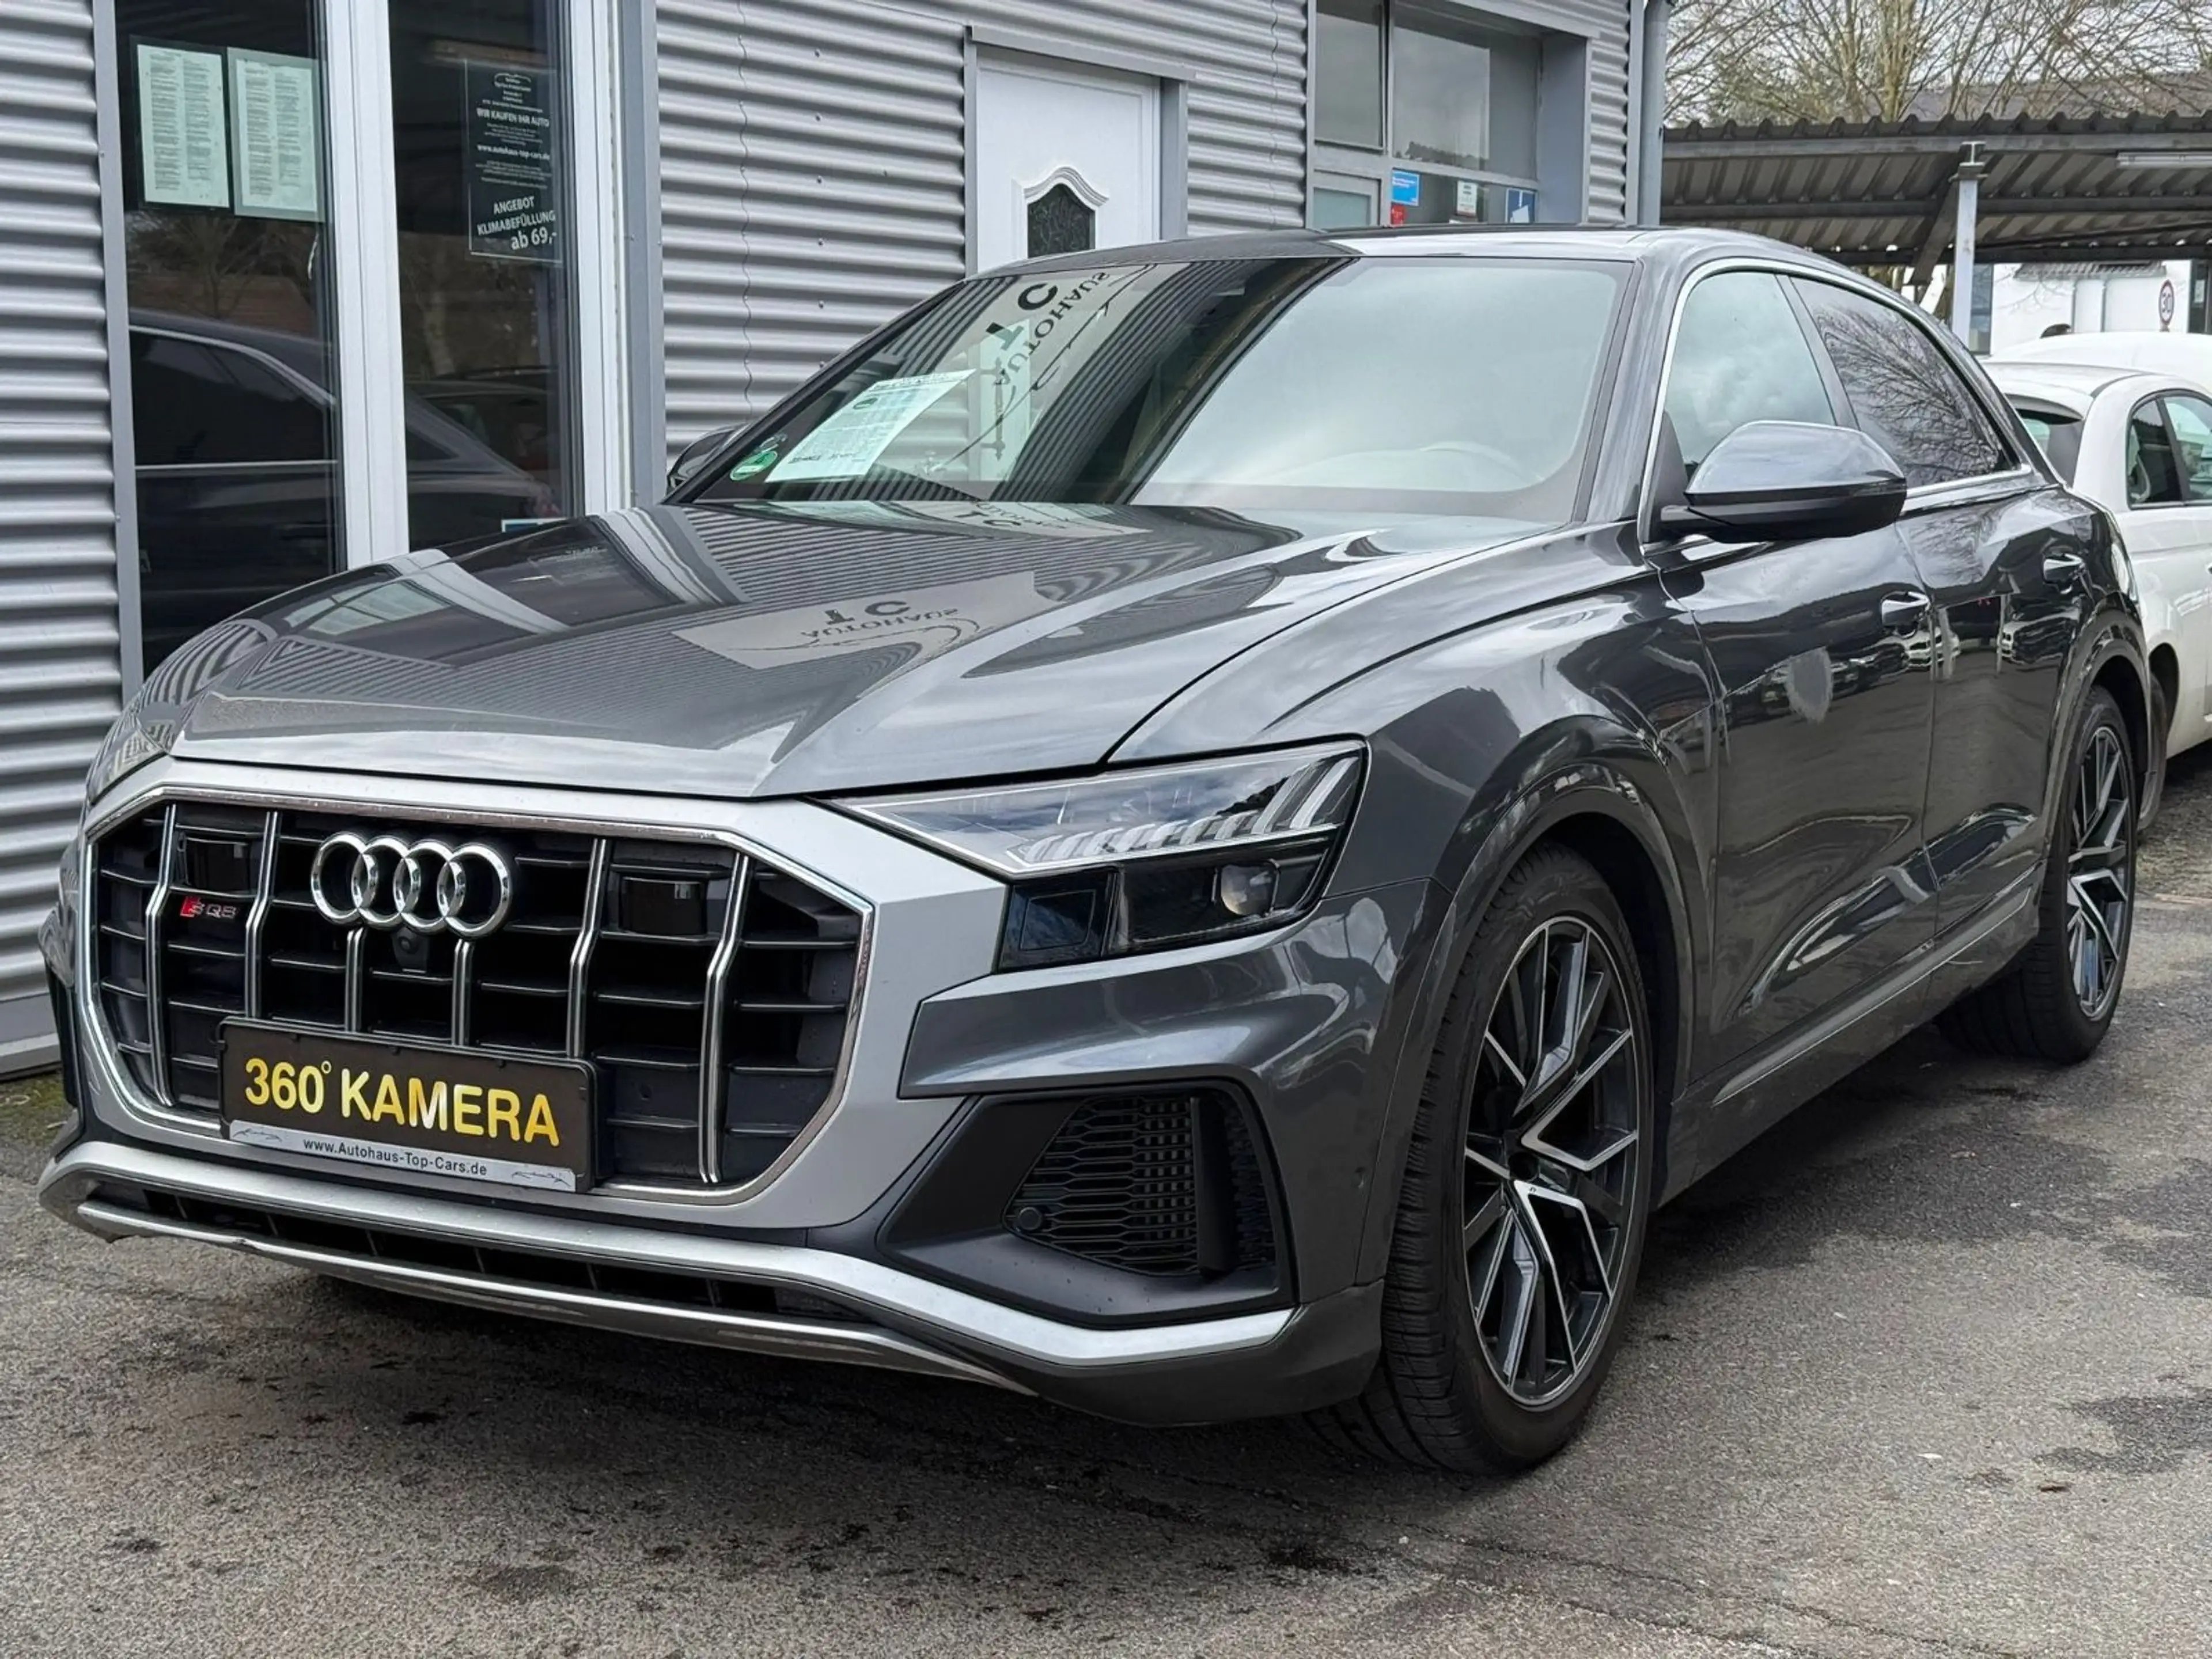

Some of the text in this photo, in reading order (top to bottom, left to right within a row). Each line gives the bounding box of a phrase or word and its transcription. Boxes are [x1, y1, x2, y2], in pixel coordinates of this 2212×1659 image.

[476, 108, 550, 127] WIR KAUFEN IHR AUTO
[494, 196, 535, 215] ANGEBOT
[477, 210, 556, 236] KLIMABEFÜLLUNG
[511, 230, 529, 250] ab
[341, 1068, 560, 1147] KAMERA
[303, 1137, 487, 1176] www.Autohaus-Top-Cars.de
